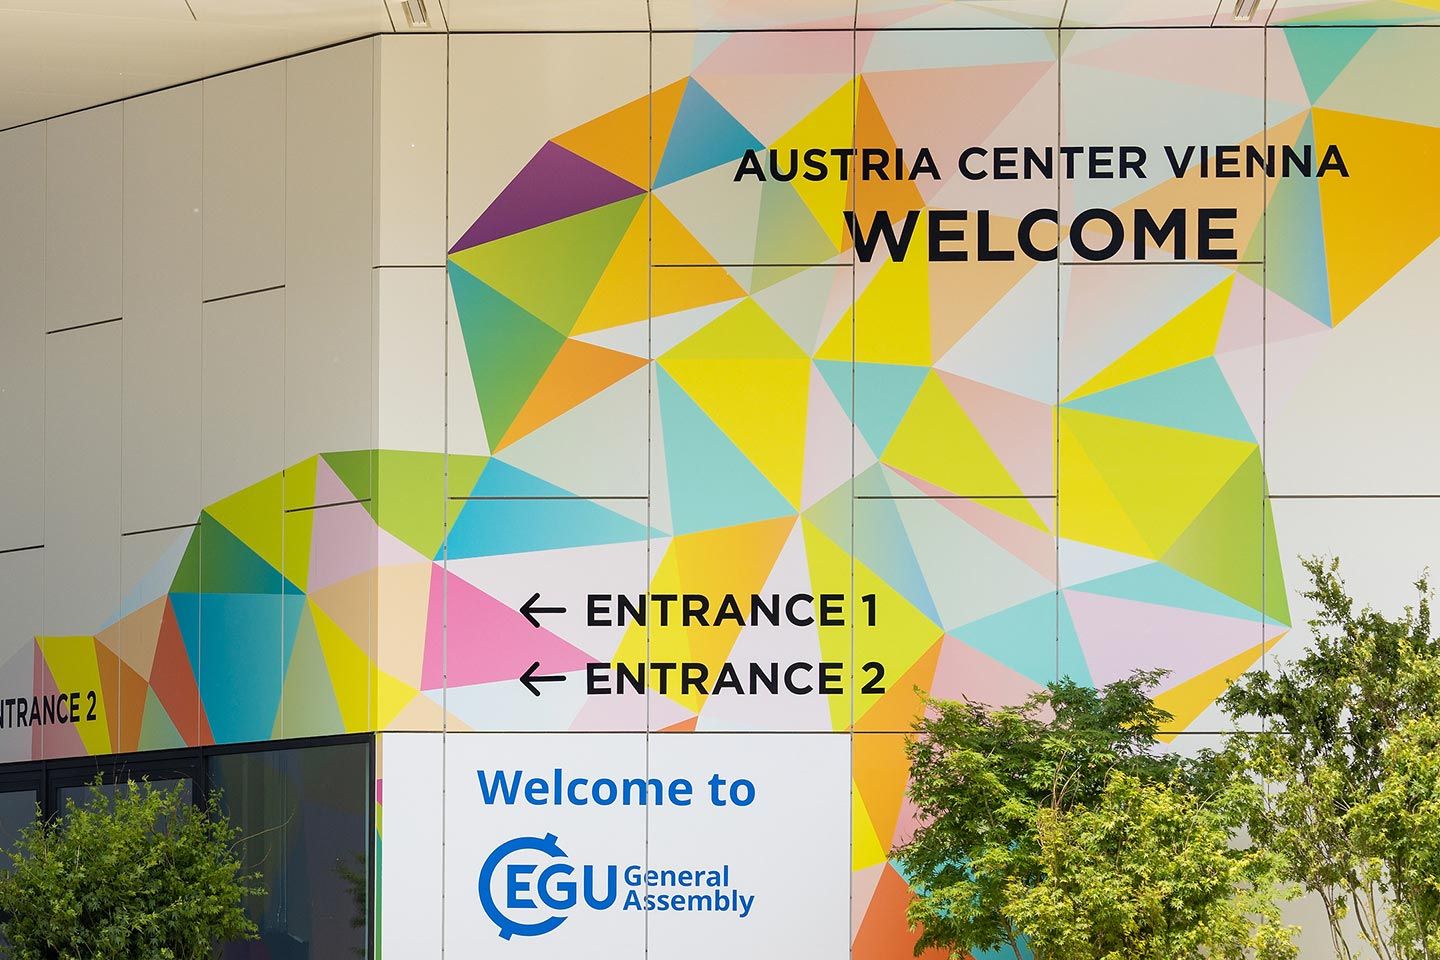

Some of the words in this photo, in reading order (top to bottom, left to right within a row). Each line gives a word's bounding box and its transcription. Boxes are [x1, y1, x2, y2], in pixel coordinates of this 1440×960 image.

[733, 147, 941, 182] AUSTRIA
[958, 146, 1148, 180] CENTER
[1164, 145, 1350, 178] VIENNA
[843, 208, 1239, 263] WELCOME
[587, 593, 846, 628] ENTRANCE
[861, 593, 877, 627] 1
[586, 662, 844, 695] ENTRANCE
[861, 662, 886, 695] 2
[87, 690, 97, 721] 2
[477, 768, 693, 807] Welcome
[708, 773, 756, 807] to
[506, 862, 618, 911] EGU
[623, 865, 728, 888] General
[622, 890, 755, 918] Assembly
